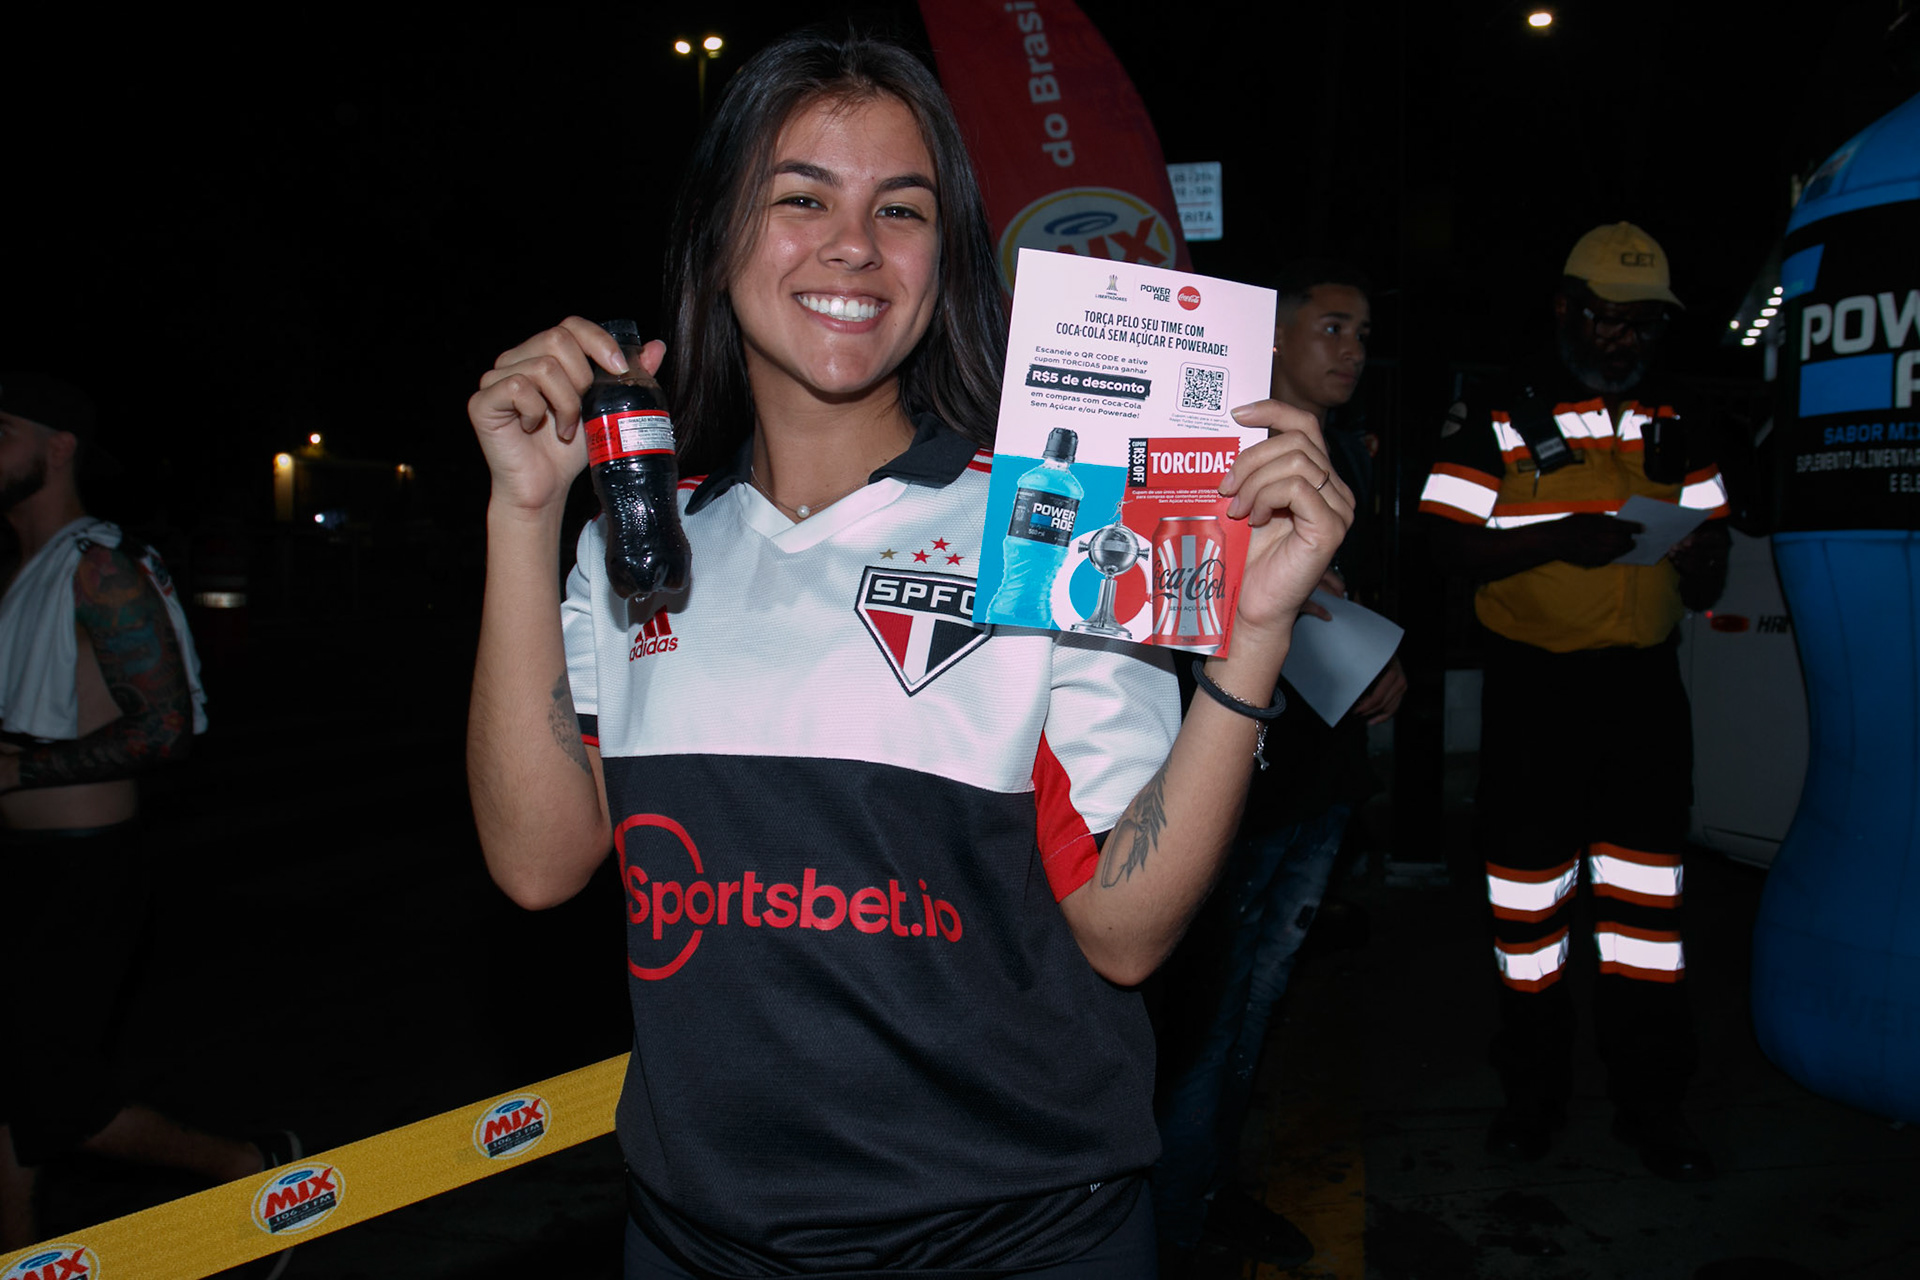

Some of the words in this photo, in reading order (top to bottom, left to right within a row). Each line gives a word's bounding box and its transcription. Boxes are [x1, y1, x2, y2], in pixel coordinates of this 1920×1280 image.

[1042, 112, 1076, 168] do
[1140, 284, 1171, 295] POWER
[1153, 293, 1171, 303] ADE
[1084, 310, 1114, 327] TORÇA
[1116, 314, 1139, 329] PELO
[1141, 318, 1158, 331] SEU
[1161, 320, 1182, 335] TIME
[1184, 324, 1204, 338] COM
[1056, 322, 1105, 340] COCA-COLA
[1107, 329, 1127, 343] SEM
[1129, 330, 1166, 348] AÇÚCAR
[1168, 336, 1174, 348] E
[1175, 338, 1228, 357] POWERADE!
[1034, 356, 1060, 364] cupom
[1102, 364, 1119, 372] para
[1121, 366, 1147, 375] ganhar
[1035, 346, 1072, 356] Escaneie
[1081, 351, 1094, 359] QR
[1096, 353, 1119, 362] CODE
[1128, 357, 1149, 366] ative
[1031, 370, 1059, 384] R$5
[1061, 374, 1079, 386] de
[1082, 376, 1146, 394] desconto
[1030, 400, 1048, 408] Sem
[1049, 402, 1077, 411] Açúcar
[1078, 406, 1096, 414] e/ou
[1098, 408, 1140, 419] Powerade!
[1045, 392, 1080, 402] compras
[1082, 397, 1100, 405] com
[1102, 399, 1142, 410] Coca-Cola
[1823, 422, 1884, 446] SABOR
[1887, 420, 1920, 441] MI
[1132, 447, 1146, 464] R$5
[1150, 451, 1235, 474] TORCIDA5
[1133, 465, 1145, 483] OFF
[1033, 502, 1076, 521] POWER
[1051, 517, 1073, 532] ADE
[871, 579, 977, 616] SPFC
[629, 636, 679, 662] adidas
[626, 865, 963, 943] Sportsbet.io
[484, 1098, 543, 1145] MIX
[264, 1166, 335, 1219] MIX
[8, 1247, 88, 1280] IX
